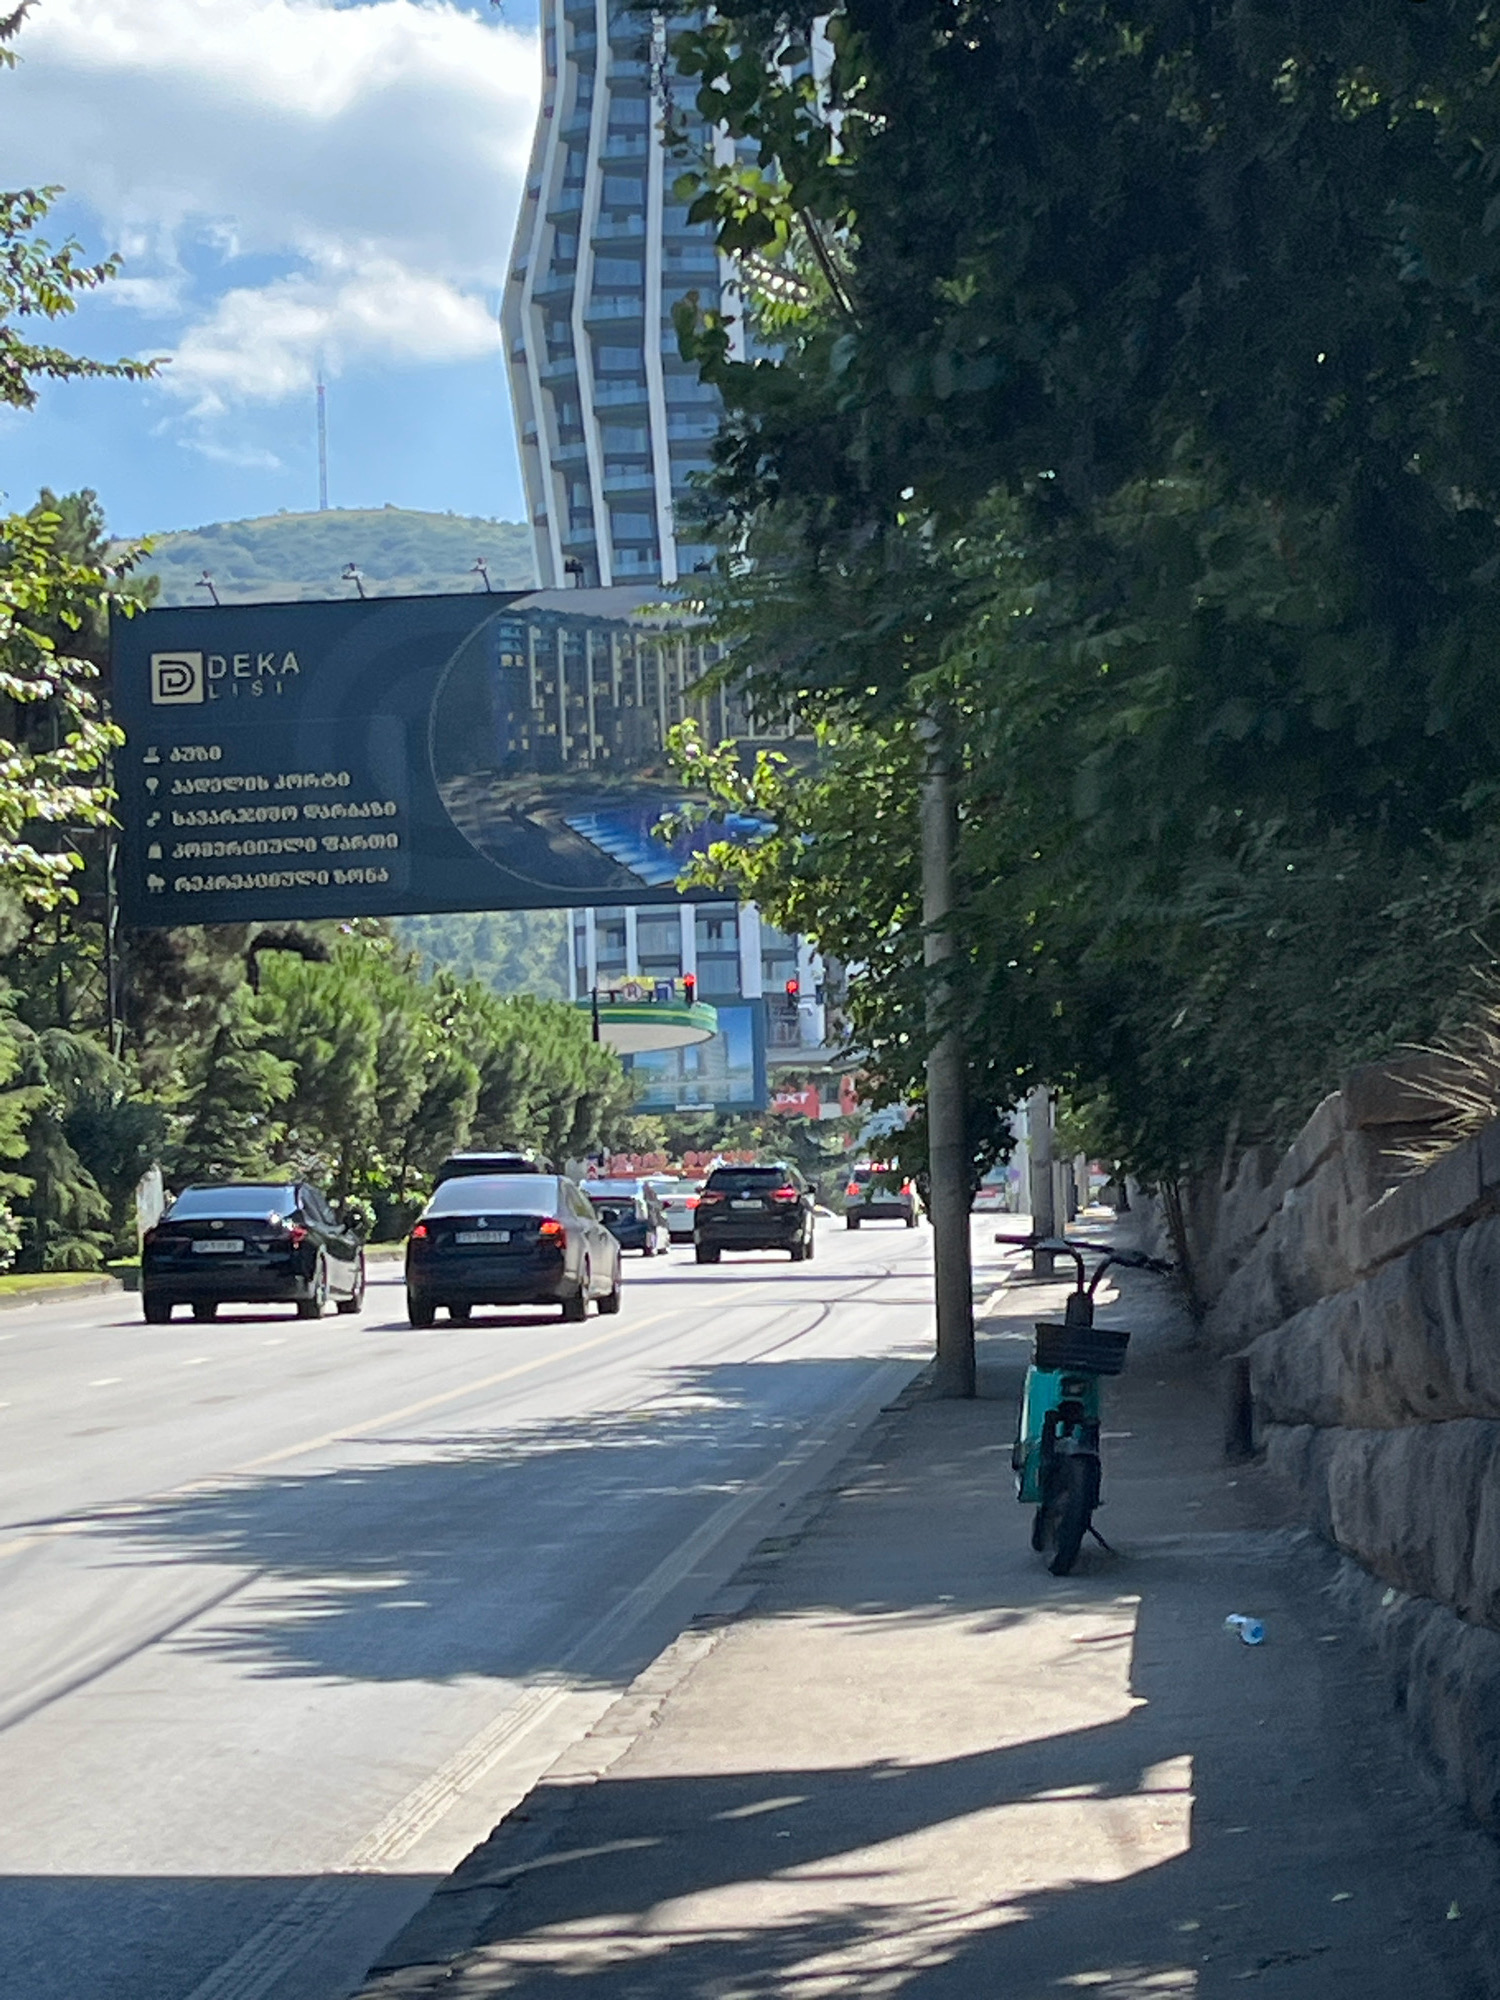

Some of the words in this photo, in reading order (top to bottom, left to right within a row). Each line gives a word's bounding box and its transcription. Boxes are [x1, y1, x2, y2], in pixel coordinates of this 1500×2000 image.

[206, 651, 301, 679] DEKA
[207, 679, 284, 700] LISI
[169, 745, 222, 762] აუზი
[171, 775, 270, 795] პადელის
[274, 771, 351, 790] კორტი
[171, 806, 298, 827] სავარჯიშო
[303, 801, 397, 820] დარბაზი
[172, 837, 318, 859] კომერციული
[321, 832, 398, 852] ფართი
[174, 869, 330, 892] რეკრეაციული
[332, 866, 390, 885] ზონა
